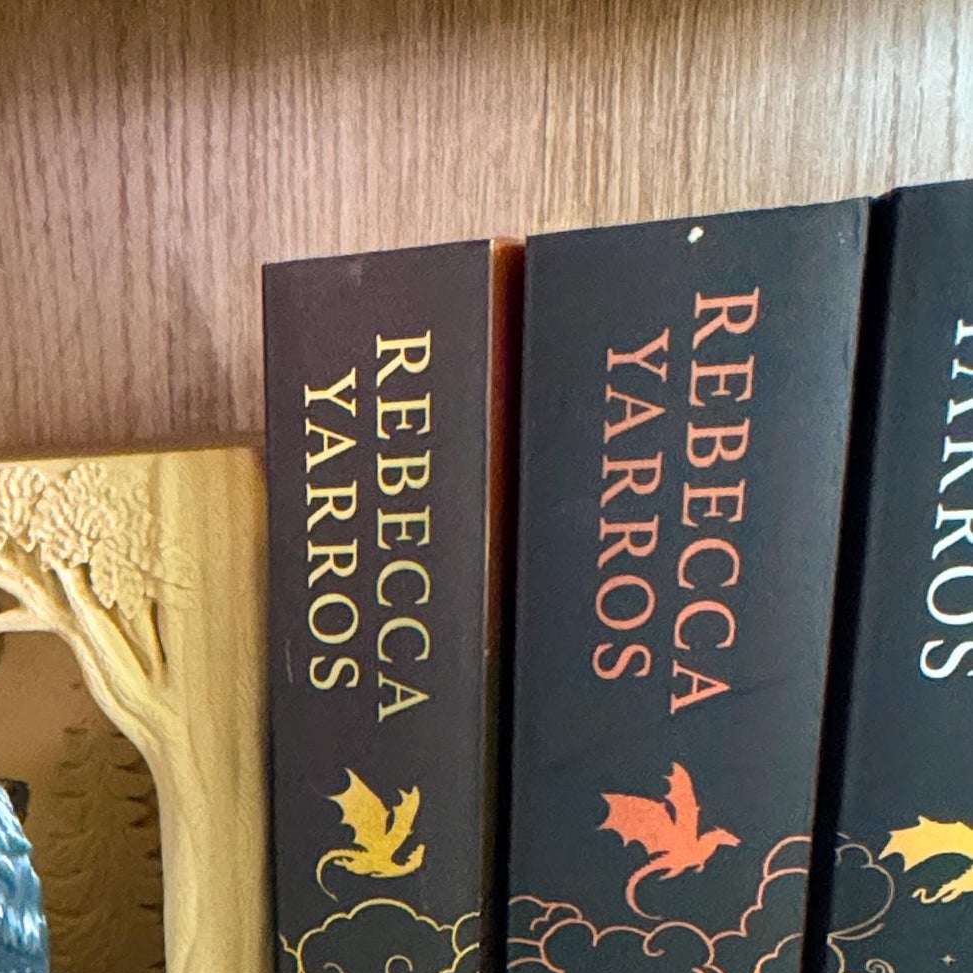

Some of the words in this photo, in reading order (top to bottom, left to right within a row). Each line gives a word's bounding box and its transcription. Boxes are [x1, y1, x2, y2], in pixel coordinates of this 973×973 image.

[303, 367, 360, 691] YARROS
[374, 330, 432, 723] REBECCA
[592, 328, 670, 680] YARROS
[670, 286, 761, 715] REBECCA
